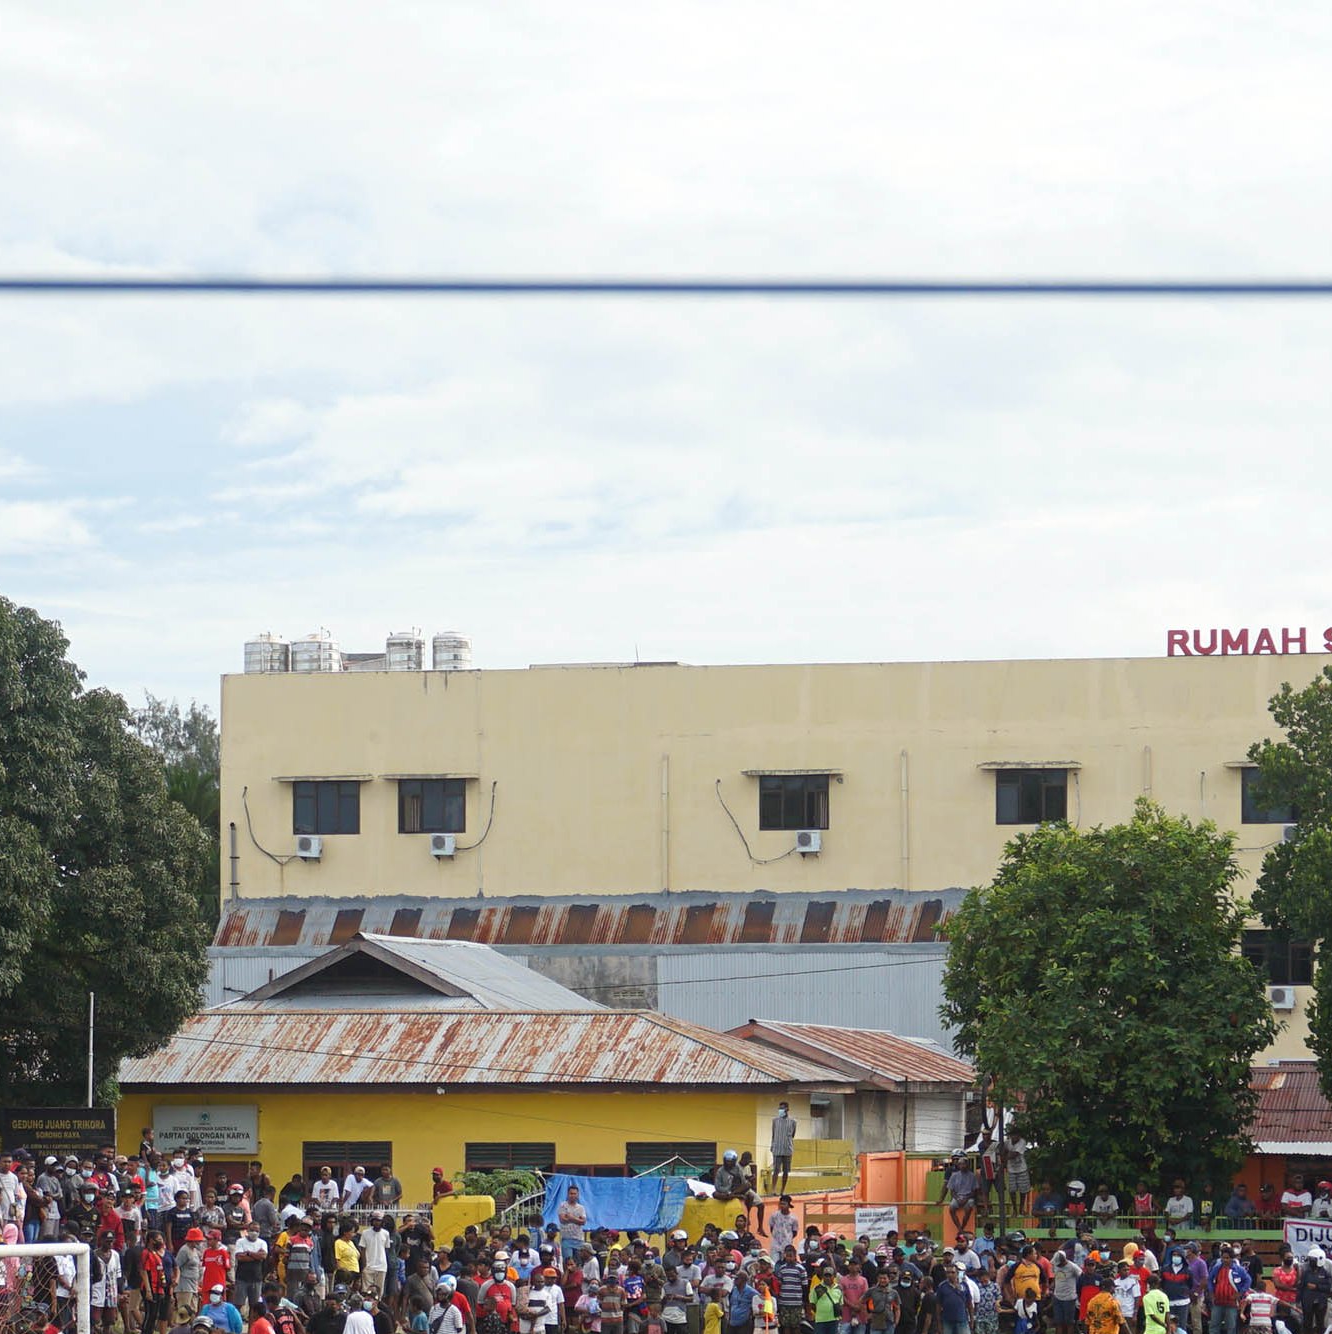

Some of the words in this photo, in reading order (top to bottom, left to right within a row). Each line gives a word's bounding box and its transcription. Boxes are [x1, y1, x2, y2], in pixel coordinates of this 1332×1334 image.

[1166, 626, 1307, 657] RUMAH
[11, 1120, 44, 1129] GEDUNG
[44, 1120, 71, 1129] JUANG
[73, 1120, 106, 1129] TRIKORA
[226, 1132, 251, 1140] KARYA
